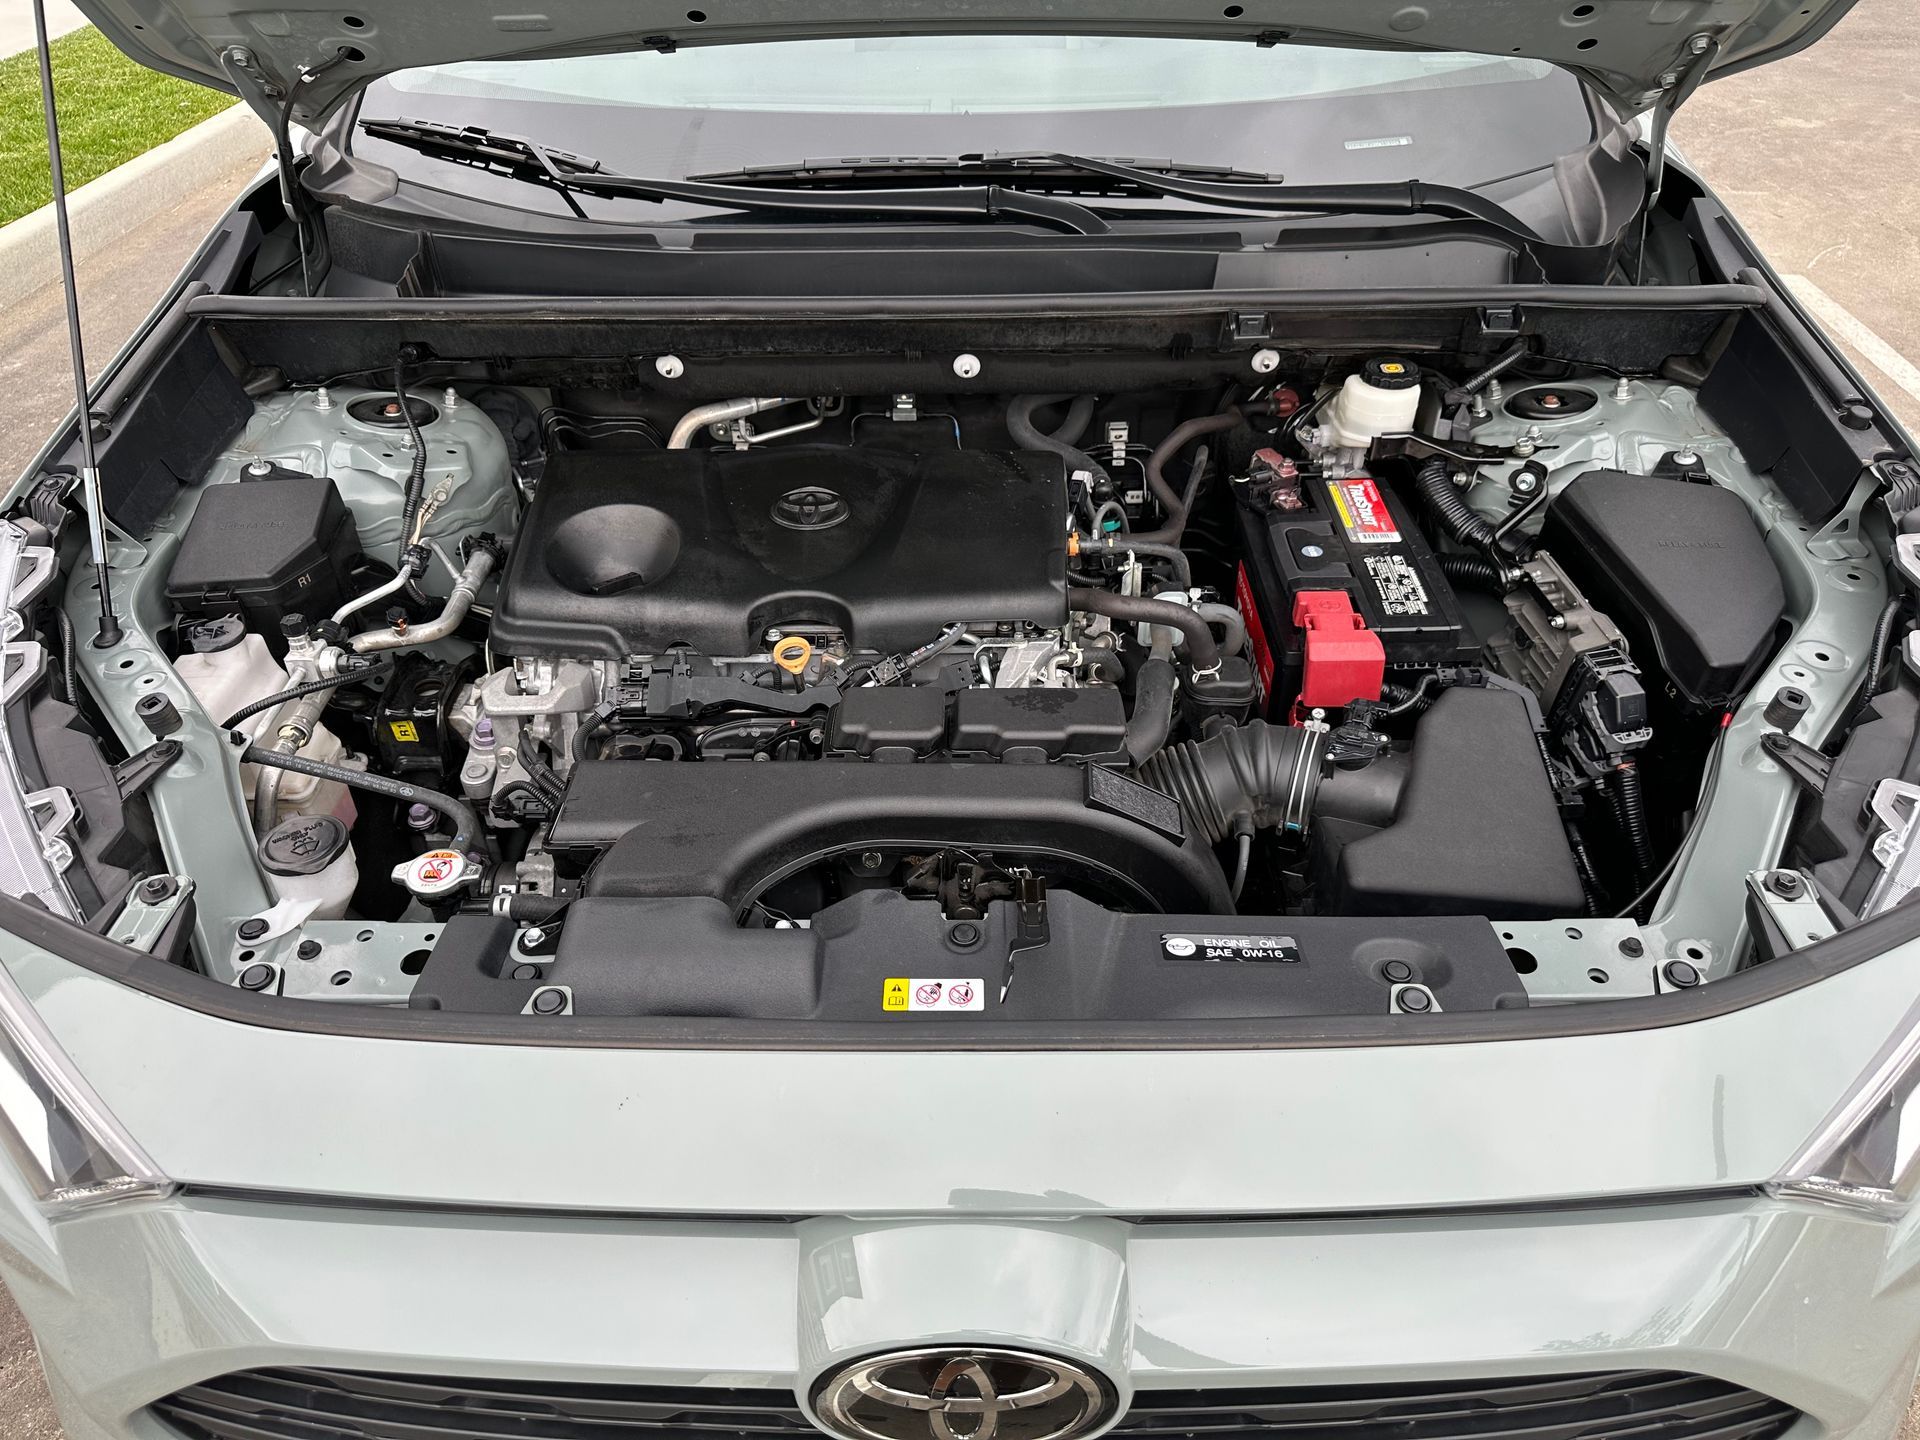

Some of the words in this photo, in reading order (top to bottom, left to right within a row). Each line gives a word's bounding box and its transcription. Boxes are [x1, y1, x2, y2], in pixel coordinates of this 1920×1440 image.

[297, 573, 312, 588] R1
[1664, 681, 1677, 699] L2
[397, 724, 410, 737] R1
[1203, 938, 1251, 948] ENGINE
[1259, 940, 1281, 949] OIL
[1206, 948, 1233, 957] SAE
[1242, 949, 1284, 958] 0W-16
